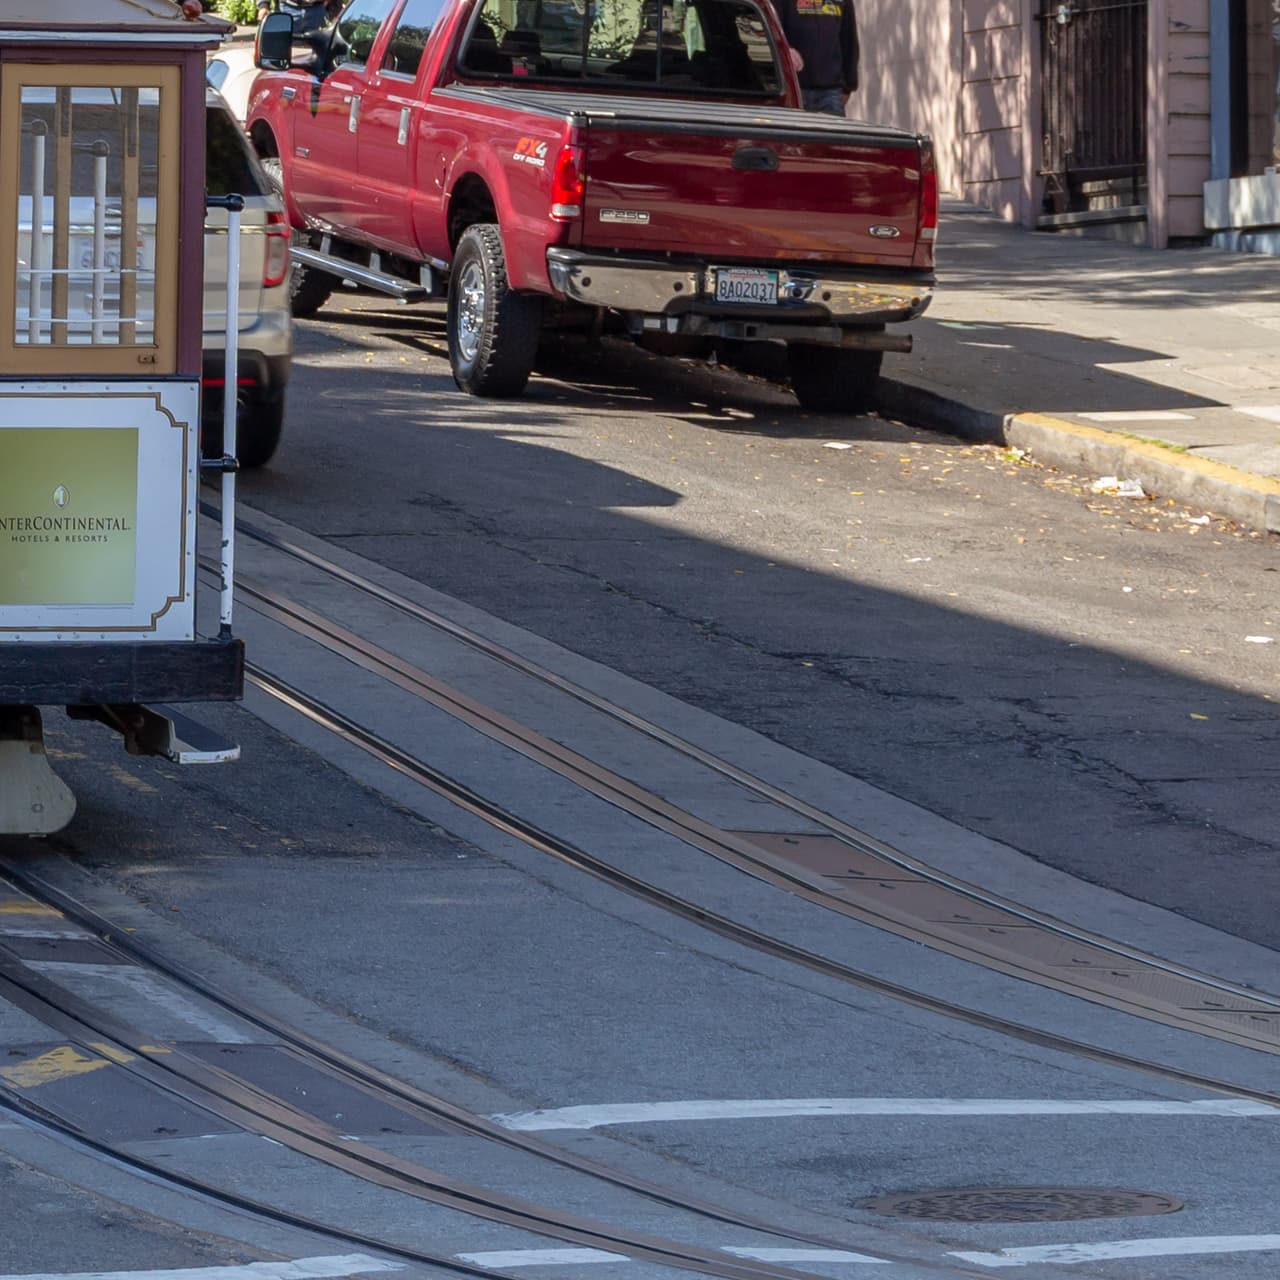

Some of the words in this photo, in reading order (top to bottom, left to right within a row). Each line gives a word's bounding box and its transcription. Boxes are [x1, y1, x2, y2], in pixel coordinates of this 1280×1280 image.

[516, 137, 548, 158] FX4
[720, 280, 775, 301] 8A02037
[65, 534, 108, 542] RESORTS
